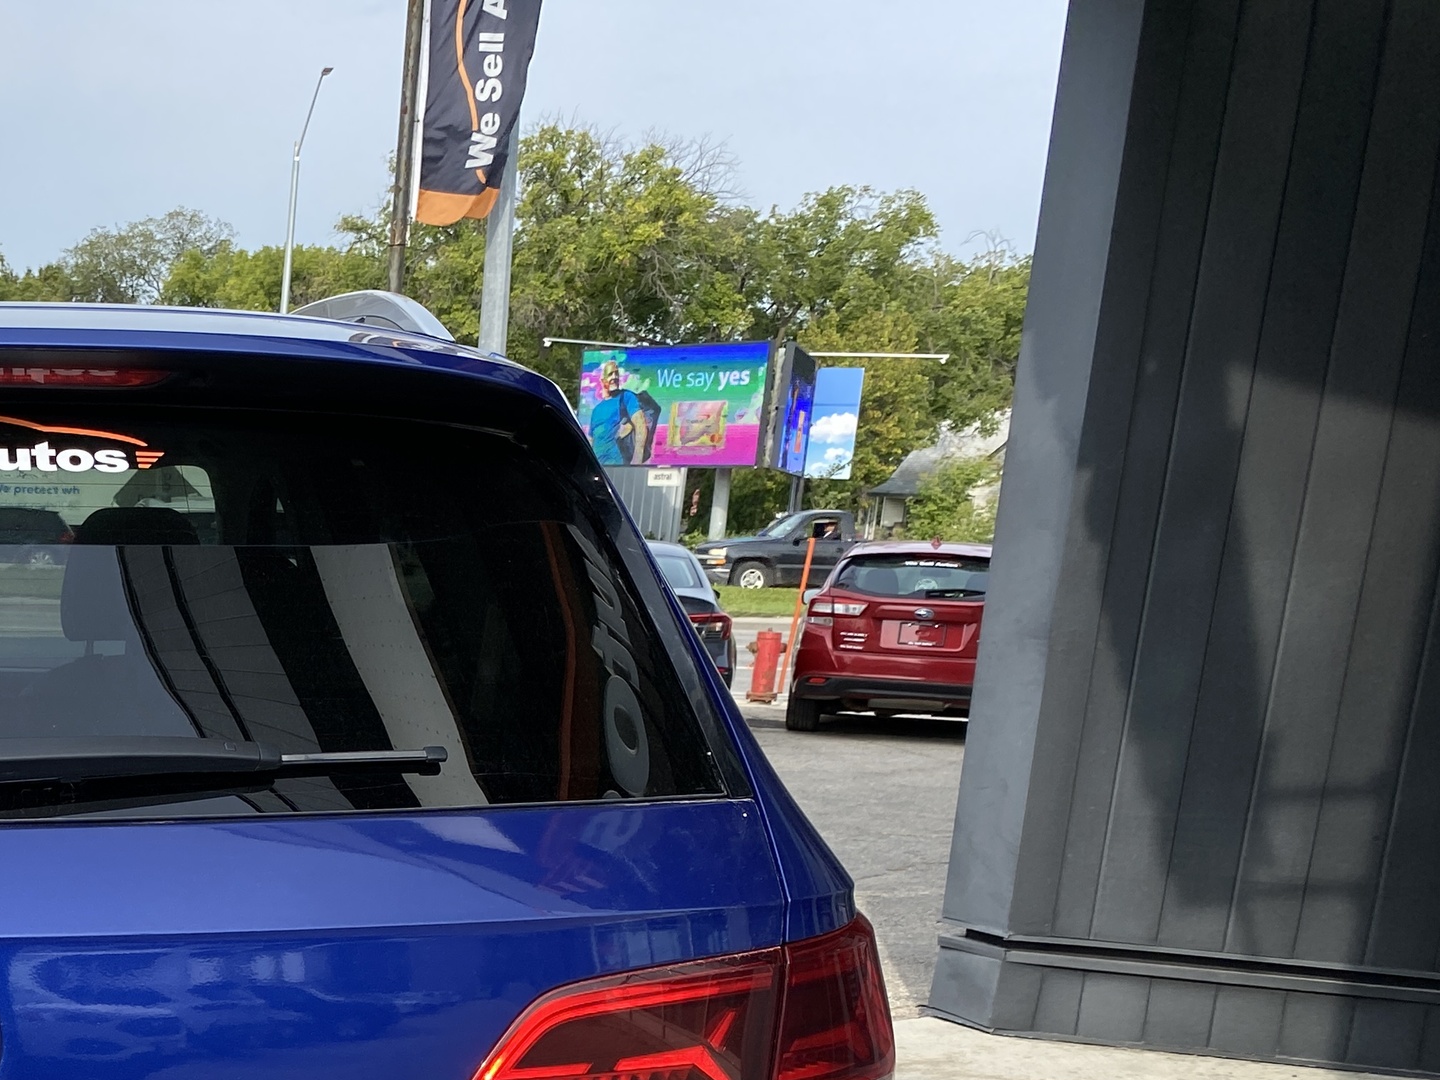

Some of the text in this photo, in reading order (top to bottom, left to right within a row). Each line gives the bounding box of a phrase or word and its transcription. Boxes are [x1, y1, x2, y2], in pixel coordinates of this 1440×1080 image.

[475, 32, 505, 102] Sell
[464, 113, 501, 169] We
[657, 368, 751, 392] We say yes
[653, 472, 673, 481] astral
